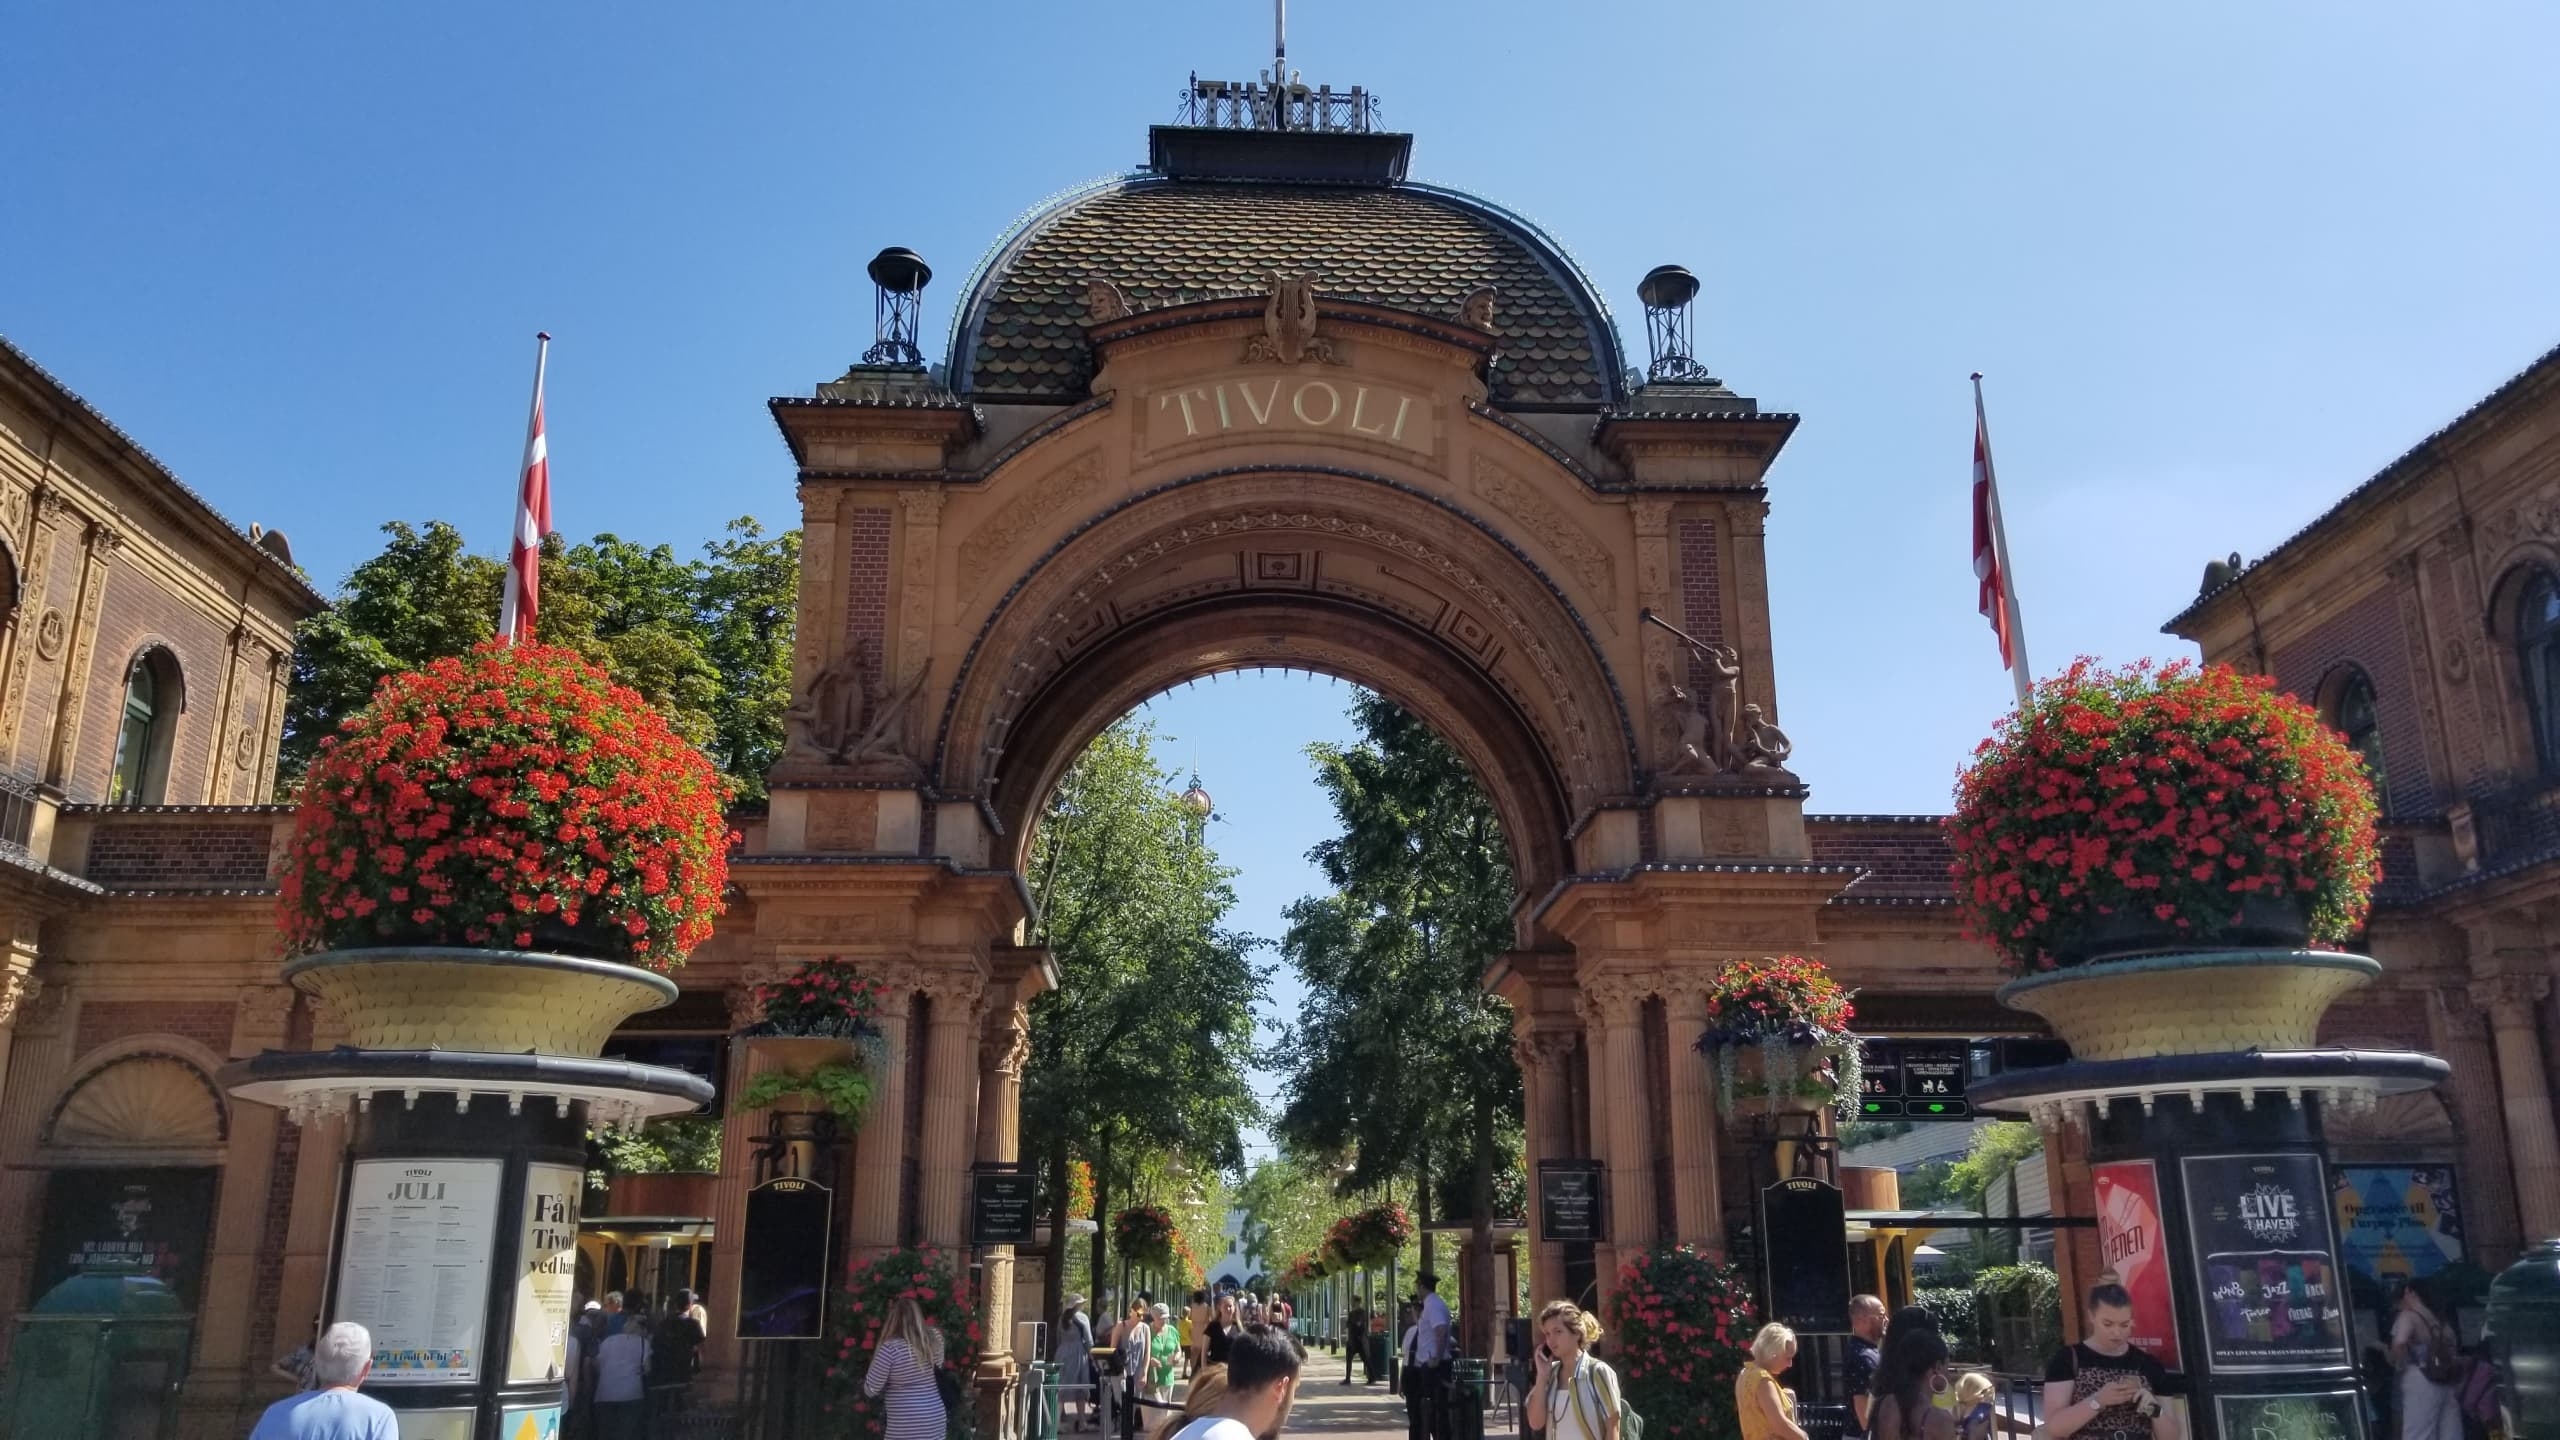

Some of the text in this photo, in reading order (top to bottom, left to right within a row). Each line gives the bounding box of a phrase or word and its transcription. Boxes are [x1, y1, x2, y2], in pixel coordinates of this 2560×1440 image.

[1198, 80, 1362, 132] TIVOLI
[1160, 379, 1411, 440] TIVOLI
[404, 1168, 433, 1177] TIVOLI
[387, 1182, 447, 1200] JULI
[773, 1181, 806, 1190] TIVOLI
[1786, 1181, 1817, 1190] TIVOLI
[534, 1193, 564, 1223] Få
[2240, 1194, 2297, 1218] LIVE
[2255, 1218, 2295, 1231] HAVEN
[532, 1228, 575, 1250] Tivoli
[530, 1256, 557, 1274] ved
[2212, 1281, 2245, 1300] MUNDO
[2261, 1281, 2291, 1299] JAZZ
